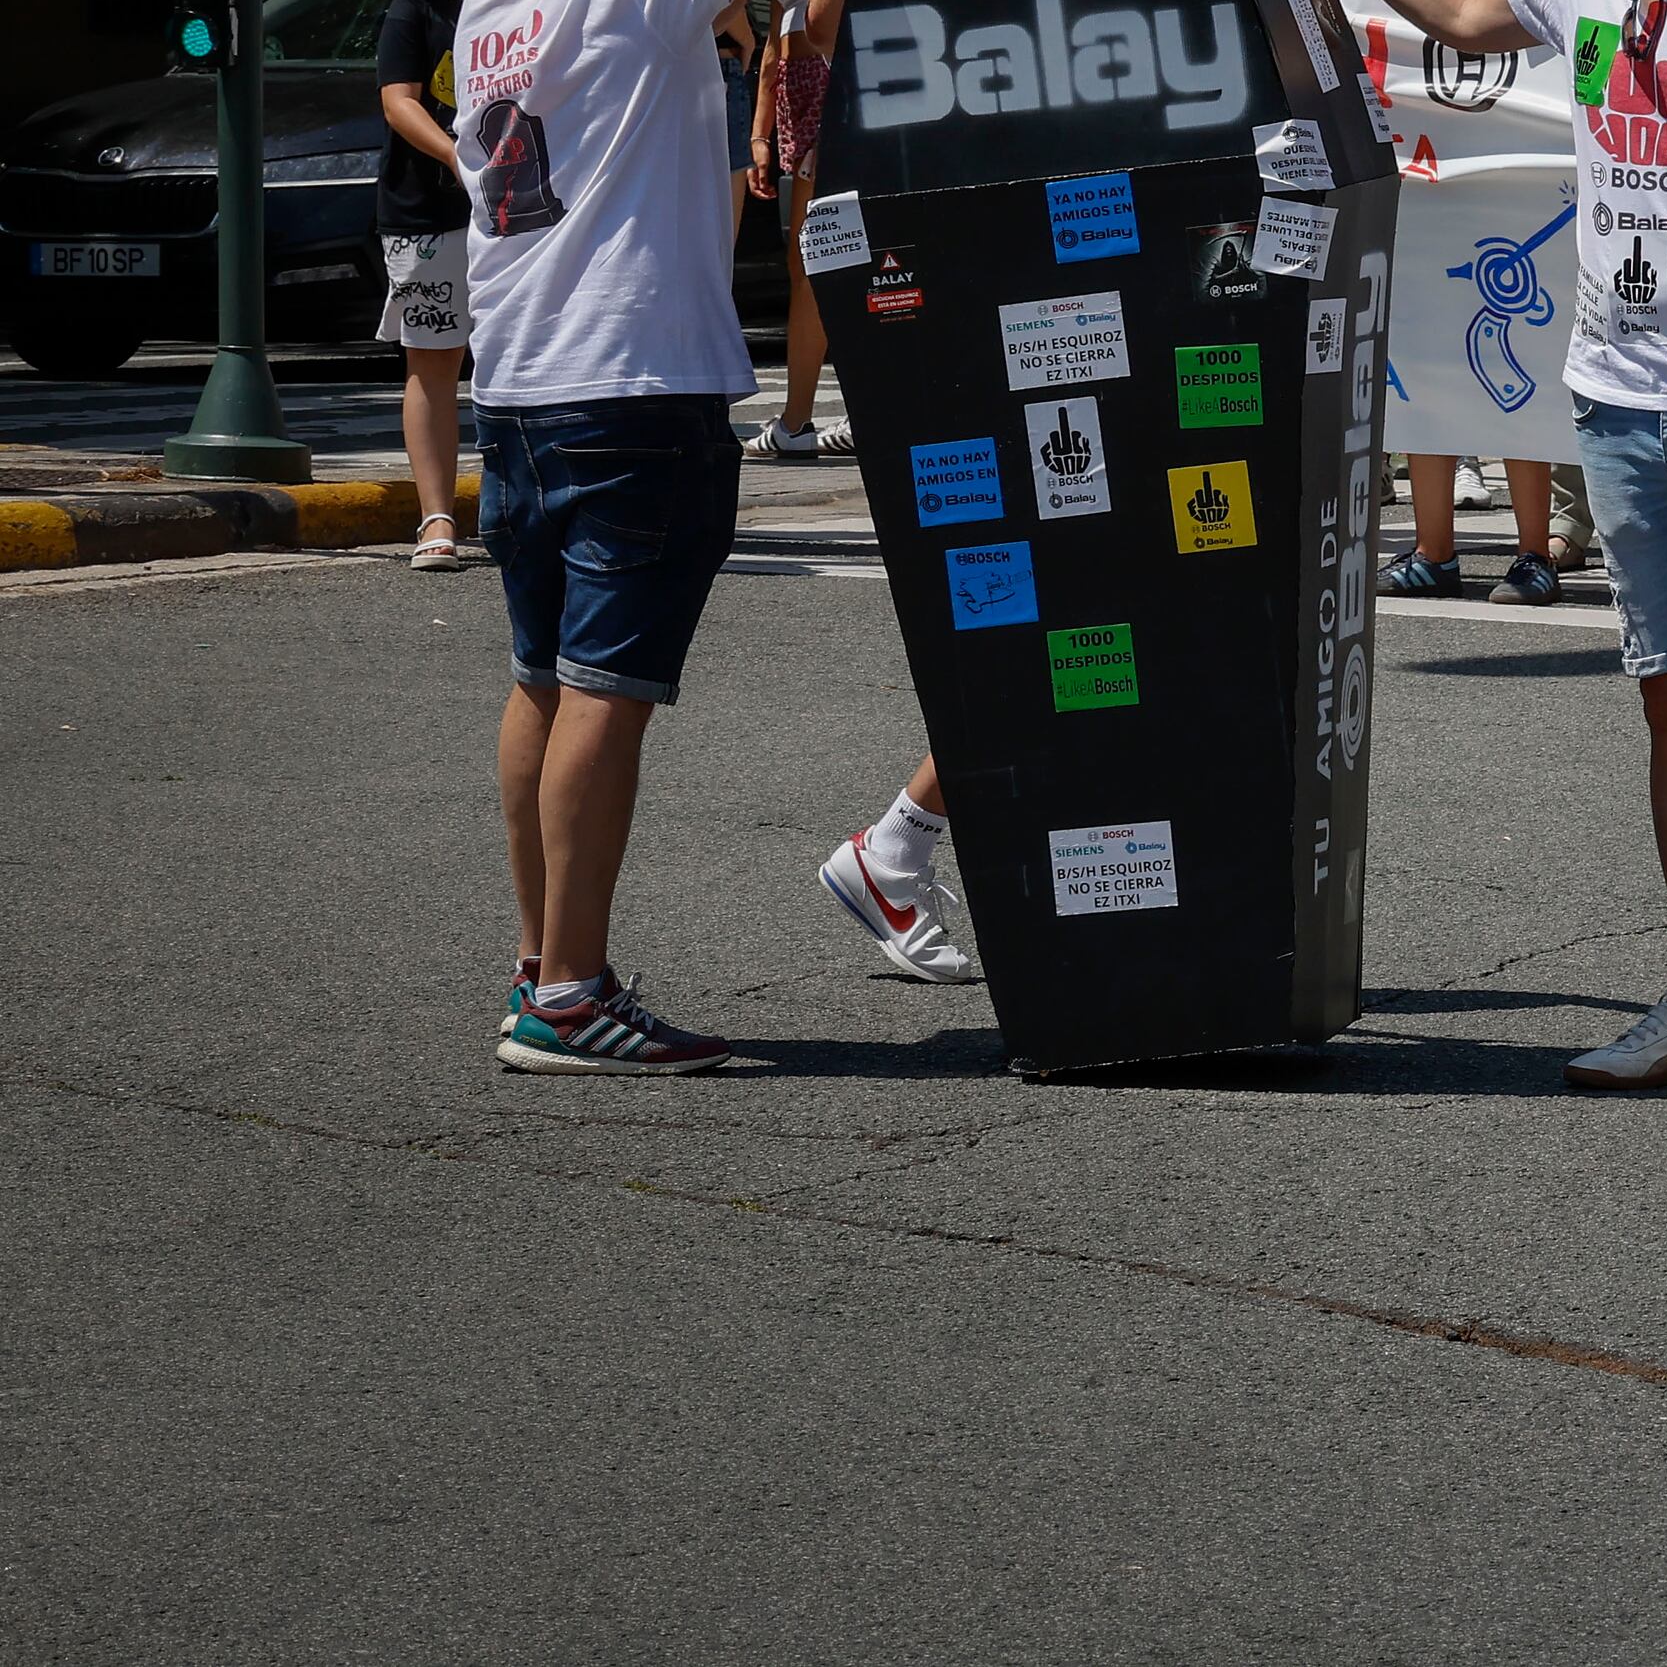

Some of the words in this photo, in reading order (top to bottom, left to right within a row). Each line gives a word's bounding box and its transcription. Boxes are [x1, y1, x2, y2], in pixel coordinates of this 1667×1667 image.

[1053, 194, 1071, 205] YA
[1074, 191, 1095, 202] NO
[1098, 186, 1126, 199] HAY
[1052, 207, 1110, 223] AMIGOS
[1113, 203, 1133, 215] EN
[1267, 212, 1310, 227] MARTES
[813, 236, 831, 247] DEL
[833, 229, 863, 242] LUNES
[1082, 227, 1133, 242] Balay
[1260, 224, 1292, 236] LUNES
[1294, 230, 1312, 239] DEL
[807, 251, 819, 260] EL
[820, 242, 861, 258] MARTES
[54, 248, 84, 273] BF
[88, 248, 109, 273] 10
[112, 248, 144, 273] SP
[1613, 235, 1658, 293] FUCK
[872, 272, 914, 286] BALAY
[1224, 282, 1258, 295] BOSCH
[1582, 285, 1599, 306] CALLE
[1617, 284, 1657, 304] YOU
[1052, 301, 1084, 313] BOSCH
[1626, 305, 1657, 315] BOSCH
[1006, 319, 1055, 333] SIEMENS
[1088, 313, 1116, 323] Balay
[1631, 323, 1660, 333] Balay
[1008, 338, 1048, 355] B/S/H
[1052, 330, 1123, 350] ESQUIROZ
[1019, 357, 1043, 370] NO
[1046, 354, 1062, 367] SE
[1065, 347, 1116, 364] CIERRA
[1195, 350, 1242, 366] 1000
[1046, 370, 1062, 382] EZ
[1066, 365, 1093, 379] ITXI
[1180, 371, 1259, 387] DESPIDOS
[1181, 396, 1259, 416] #LikeABosch
[1040, 407, 1092, 466] FUCK
[1338, 251, 1388, 640] Balay
[918, 457, 935, 469] YA
[939, 455, 960, 467] NO
[963, 451, 990, 464] HAY
[1047, 455, 1090, 476] YOU
[917, 469, 974, 486] AMIGOS
[978, 467, 997, 479] EN
[1058, 474, 1094, 487] BOSCH
[945, 491, 997, 506] Balay
[1064, 493, 1097, 504] Balay
[1187, 471, 1230, 516] FUCK
[1193, 507, 1229, 524] YOU
[1201, 522, 1231, 532] BOSCH
[1319, 496, 1338, 568] DE
[967, 551, 1011, 564] BOSCH
[1067, 631, 1114, 649] 1000
[1054, 652, 1132, 671] DESPIDOS
[1056, 676, 1133, 699] #LikeABosch
[1316, 589, 1337, 780] AMIGO
[1102, 830, 1134, 840] BOSCH
[1055, 846, 1105, 858] SIEMENS
[1138, 842, 1166, 851] Balay
[1314, 818, 1331, 895] TU
[1057, 867, 1097, 880] B/S/H
[1101, 859, 1172, 876] ESQUIROZ
[1068, 883, 1090, 895] NO
[1094, 881, 1110, 892] SE
[1114, 876, 1164, 890] CIERRA
[1094, 896, 1110, 908] EZ
[1114, 893, 1140, 906] ITXI
